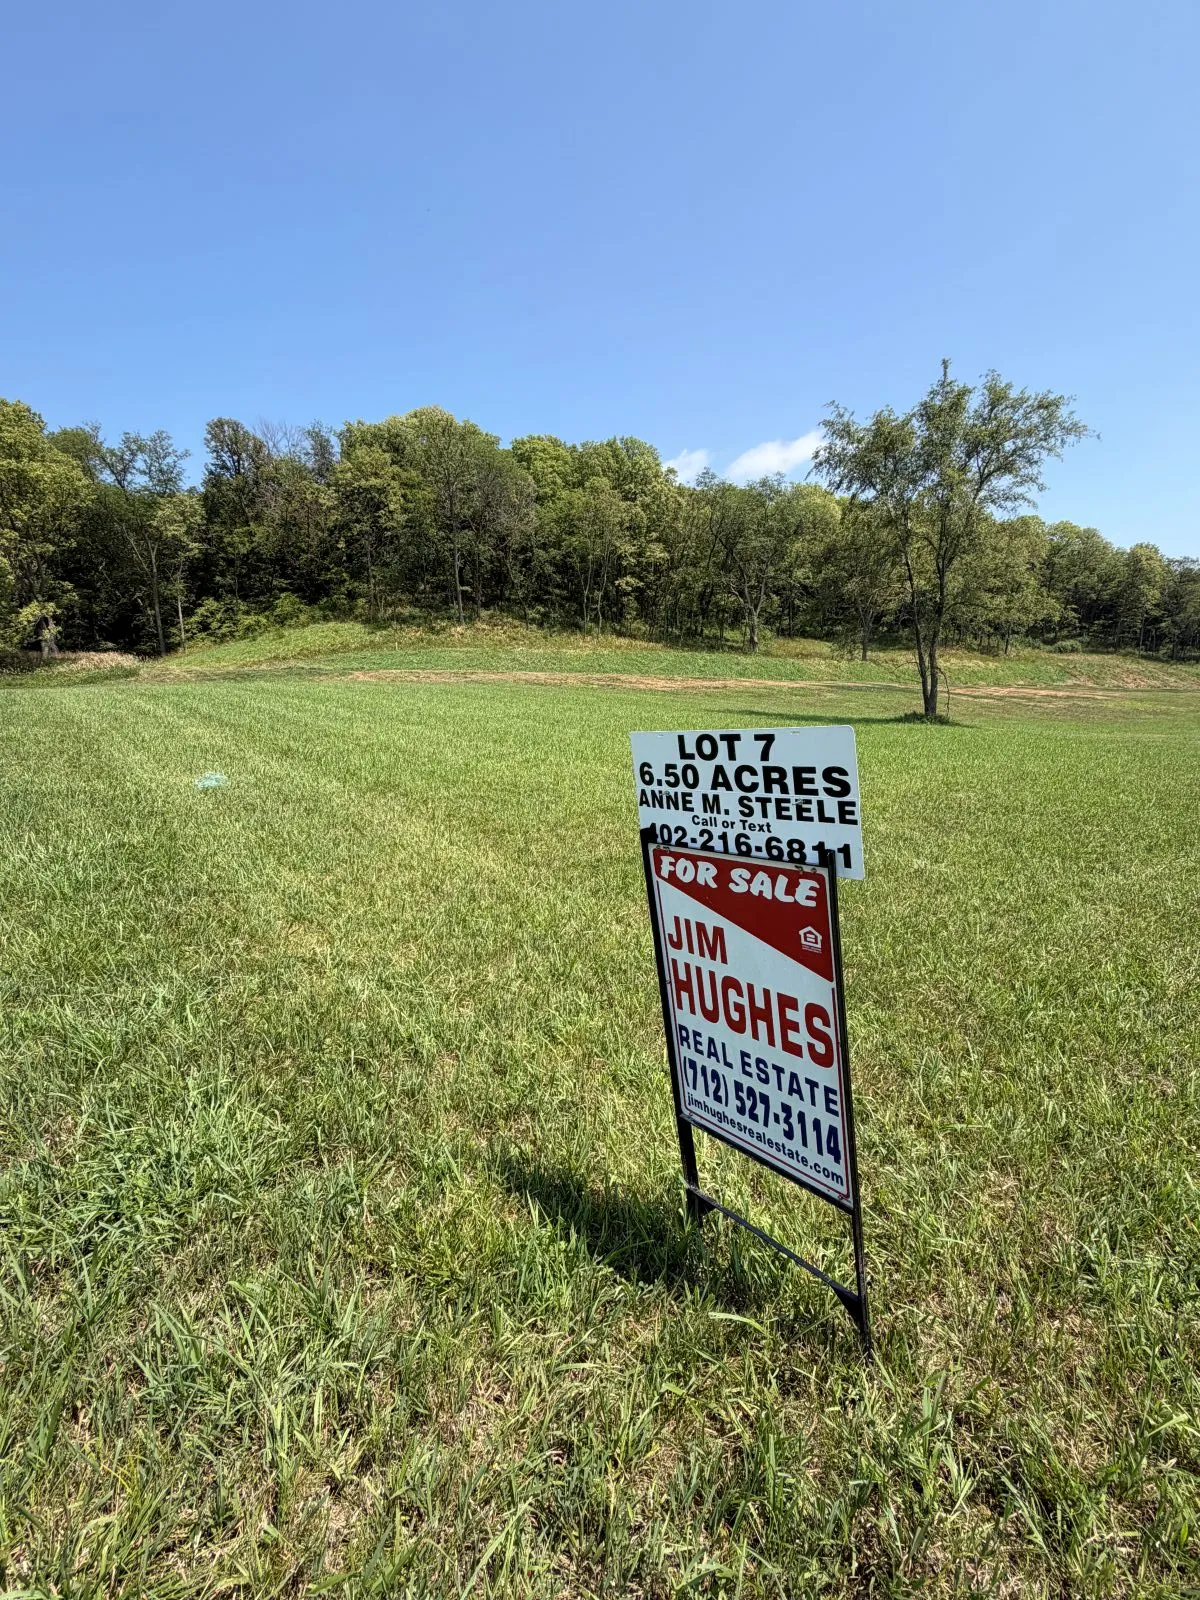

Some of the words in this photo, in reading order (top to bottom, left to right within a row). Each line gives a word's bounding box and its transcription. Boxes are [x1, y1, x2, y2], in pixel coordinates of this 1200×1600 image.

[677, 733, 741, 761] LOT
[753, 733, 776, 762] 7
[639, 762, 700, 790] 6.50
[710, 764, 852, 798] ACRES
[638, 788, 695, 812] ANNE
[701, 793, 730, 816] M.
[738, 795, 859, 826] STEELE
[691, 815, 718, 828] Call
[721, 816, 736, 830] or
[739, 819, 772, 834] Text
[660, 856, 718, 888] FOR
[728, 868, 820, 907] SALE
[667, 915, 728, 965] JIM
[671, 958, 834, 1069] HUGHES
[678, 1023, 734, 1069] REAL
[739, 1049, 840, 1118] ESTATE
[683, 1055, 729, 1107] (712)
[733, 1079, 842, 1166] 527-3114
[686, 1092, 844, 1187] jimhughesrealestate.com
